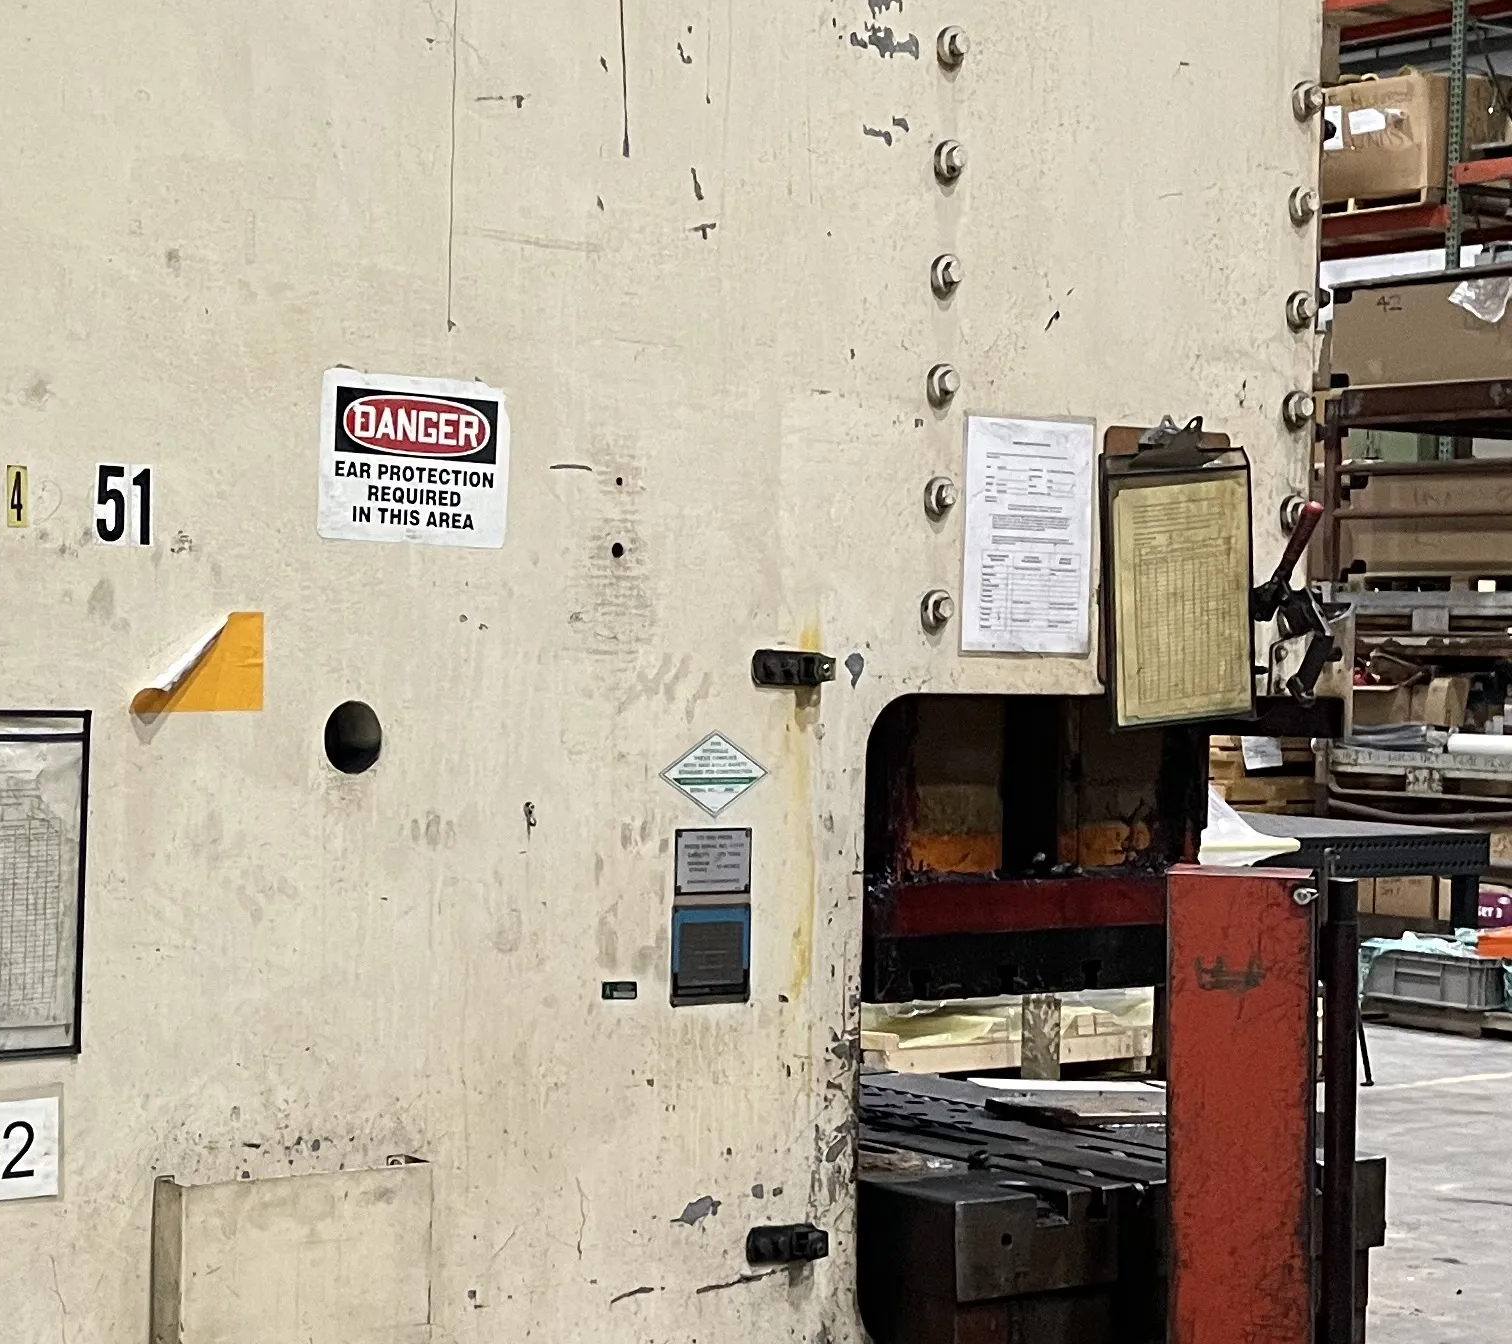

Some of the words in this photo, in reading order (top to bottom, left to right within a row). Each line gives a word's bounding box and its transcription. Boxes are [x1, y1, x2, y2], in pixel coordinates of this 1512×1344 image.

[352, 404, 480, 448] DANGER
[334, 460, 371, 479] EAR
[377, 463, 494, 488] PROTECTION
[10, 471, 23, 522] 4
[96, 464, 151, 546] 51
[367, 484, 461, 507] REQUIRED
[352, 506, 371, 523] IN
[377, 507, 420, 526] THIS
[426, 511, 474, 530] AREA
